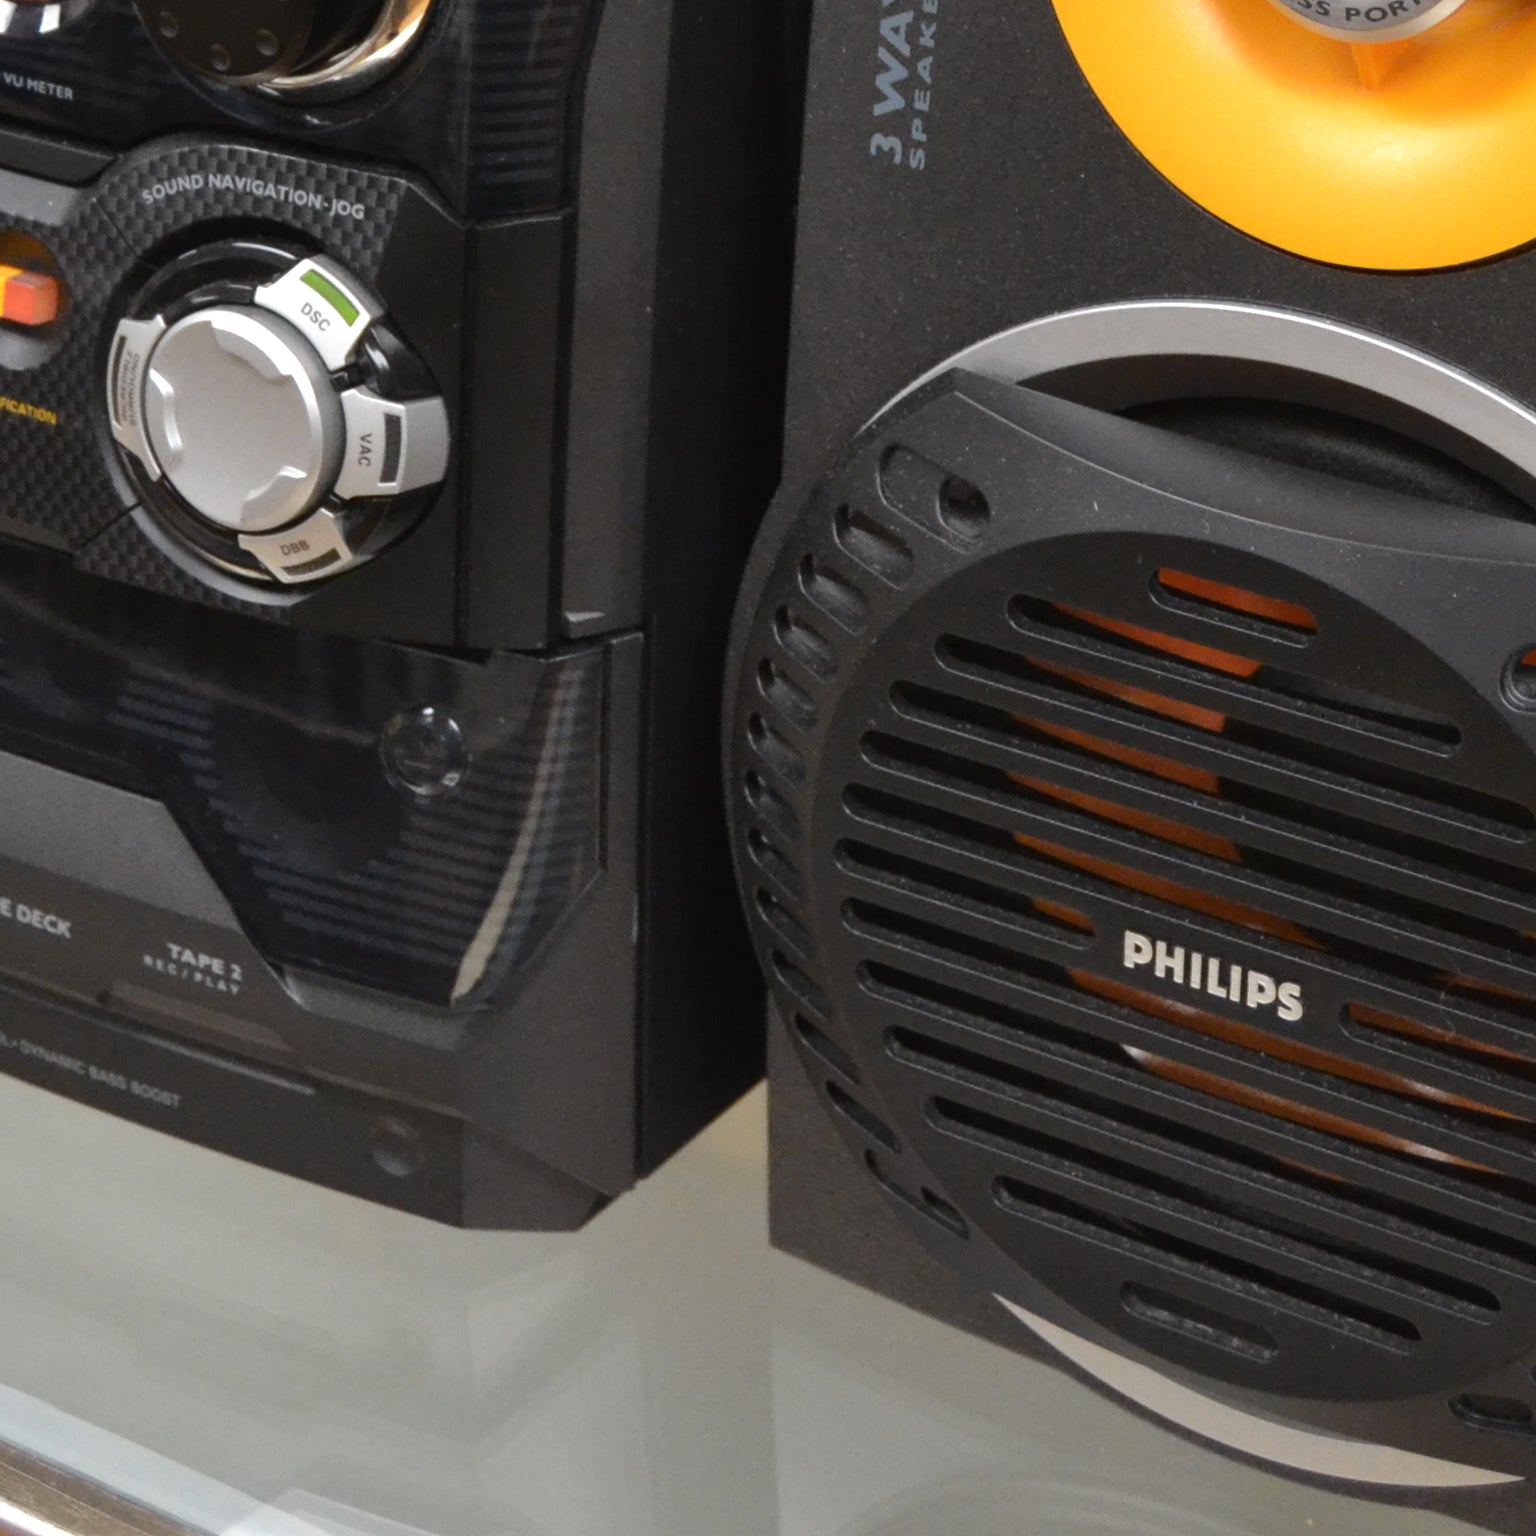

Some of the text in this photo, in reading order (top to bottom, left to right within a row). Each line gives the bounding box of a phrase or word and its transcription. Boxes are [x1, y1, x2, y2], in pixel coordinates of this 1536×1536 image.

[3, 71, 24, 88] VU
[26, 77, 74, 102] METER
[870, 131, 903, 165] 3
[142, 174, 205, 205] SOUND
[299, 301, 331, 332] DSC
[357, 432, 374, 468] VAC
[279, 539, 311, 557] DBB
[15, 903, 73, 940] DECK
[166, 941, 244, 982] TAPE 2
[1123, 928, 1304, 1022] PHILIPS
